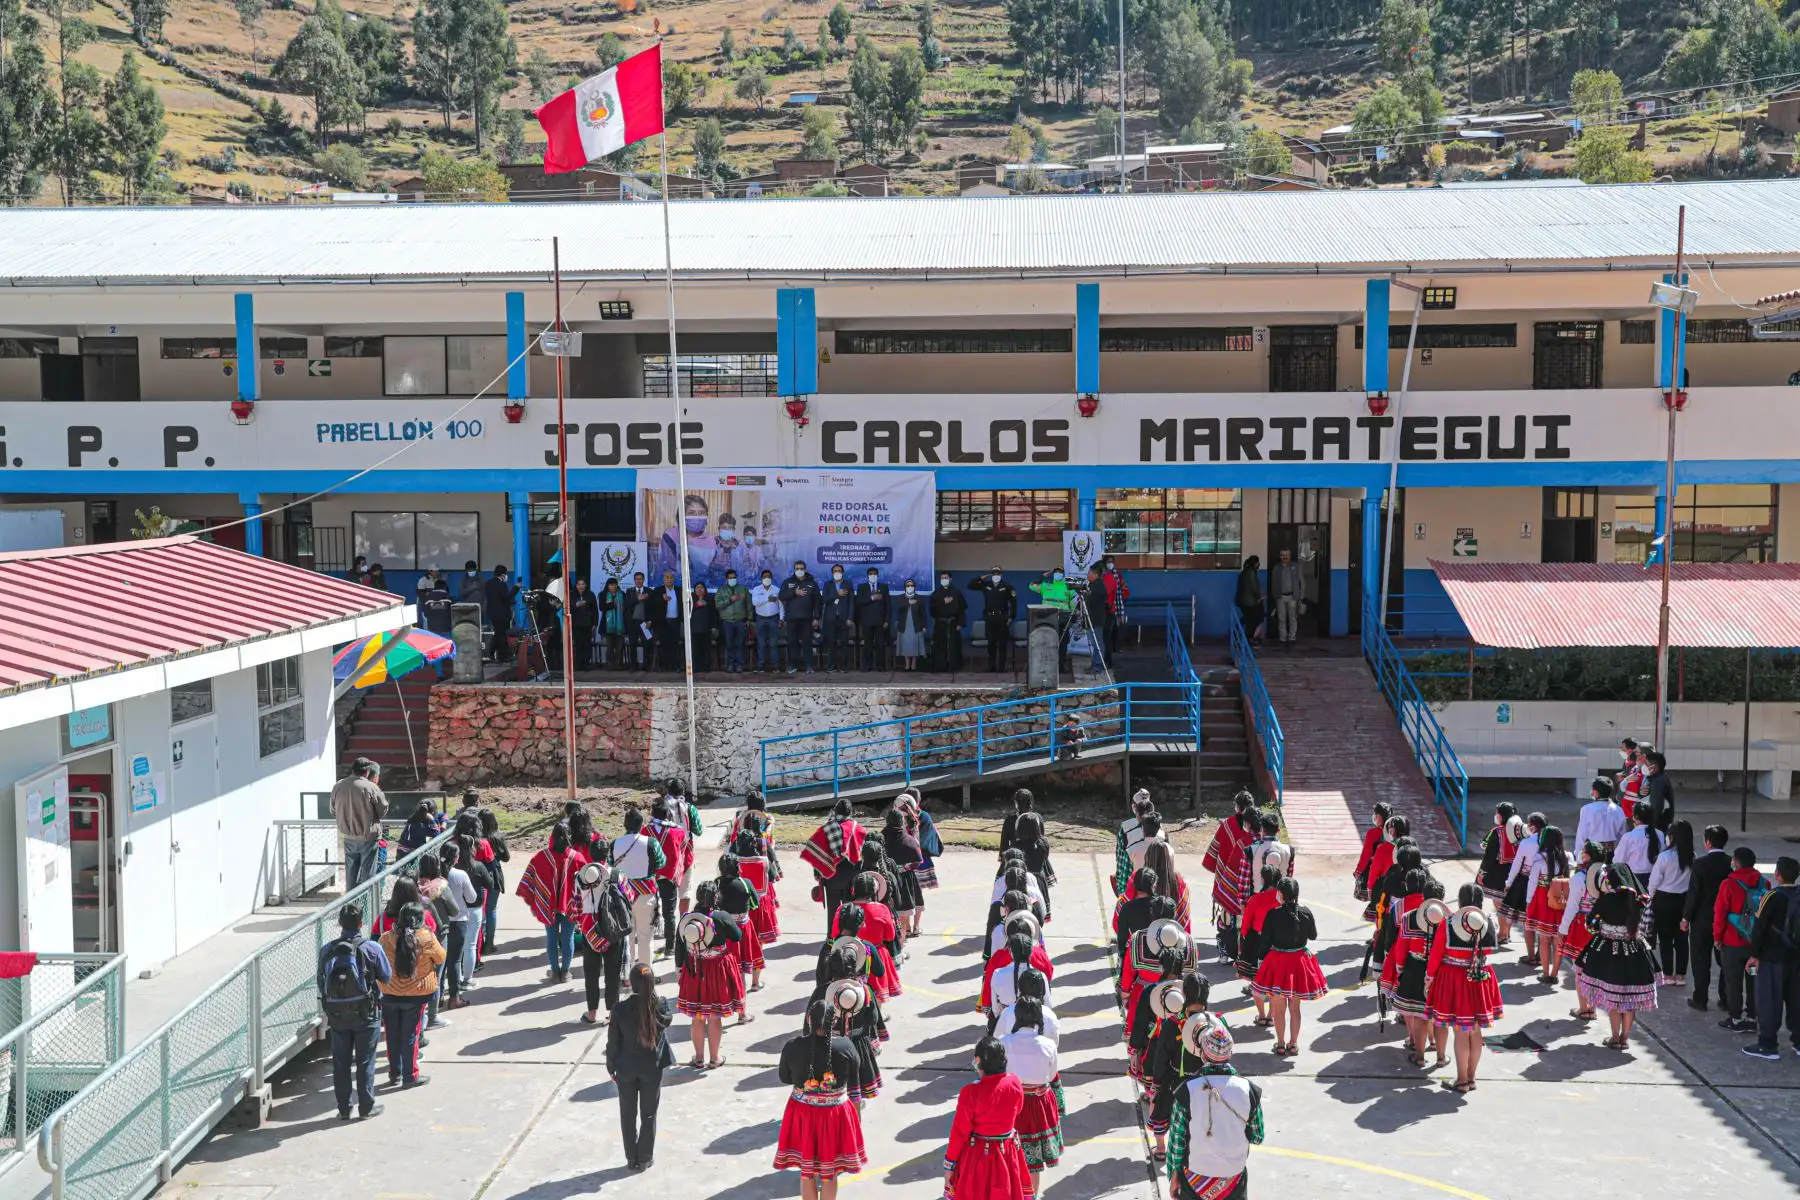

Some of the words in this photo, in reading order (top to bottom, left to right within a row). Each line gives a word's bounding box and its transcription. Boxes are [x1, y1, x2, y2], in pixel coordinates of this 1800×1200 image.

[445, 419, 483, 440] 100
[67, 425, 119, 467] P.
[163, 425, 215, 467] P.
[544, 422, 704, 466] JOSE
[821, 419, 1070, 464] CARLOS
[1139, 415, 1571, 462] MARIATEGUI
[821, 502, 843, 511] RED
[845, 502, 889, 511] DORSAL
[819, 513, 874, 522] NACIONAL
[876, 513, 891, 523] DE
[75, 528, 83, 538] S
[818, 525, 850, 534] FIBRA
[852, 523, 891, 535] ÓPTICA
